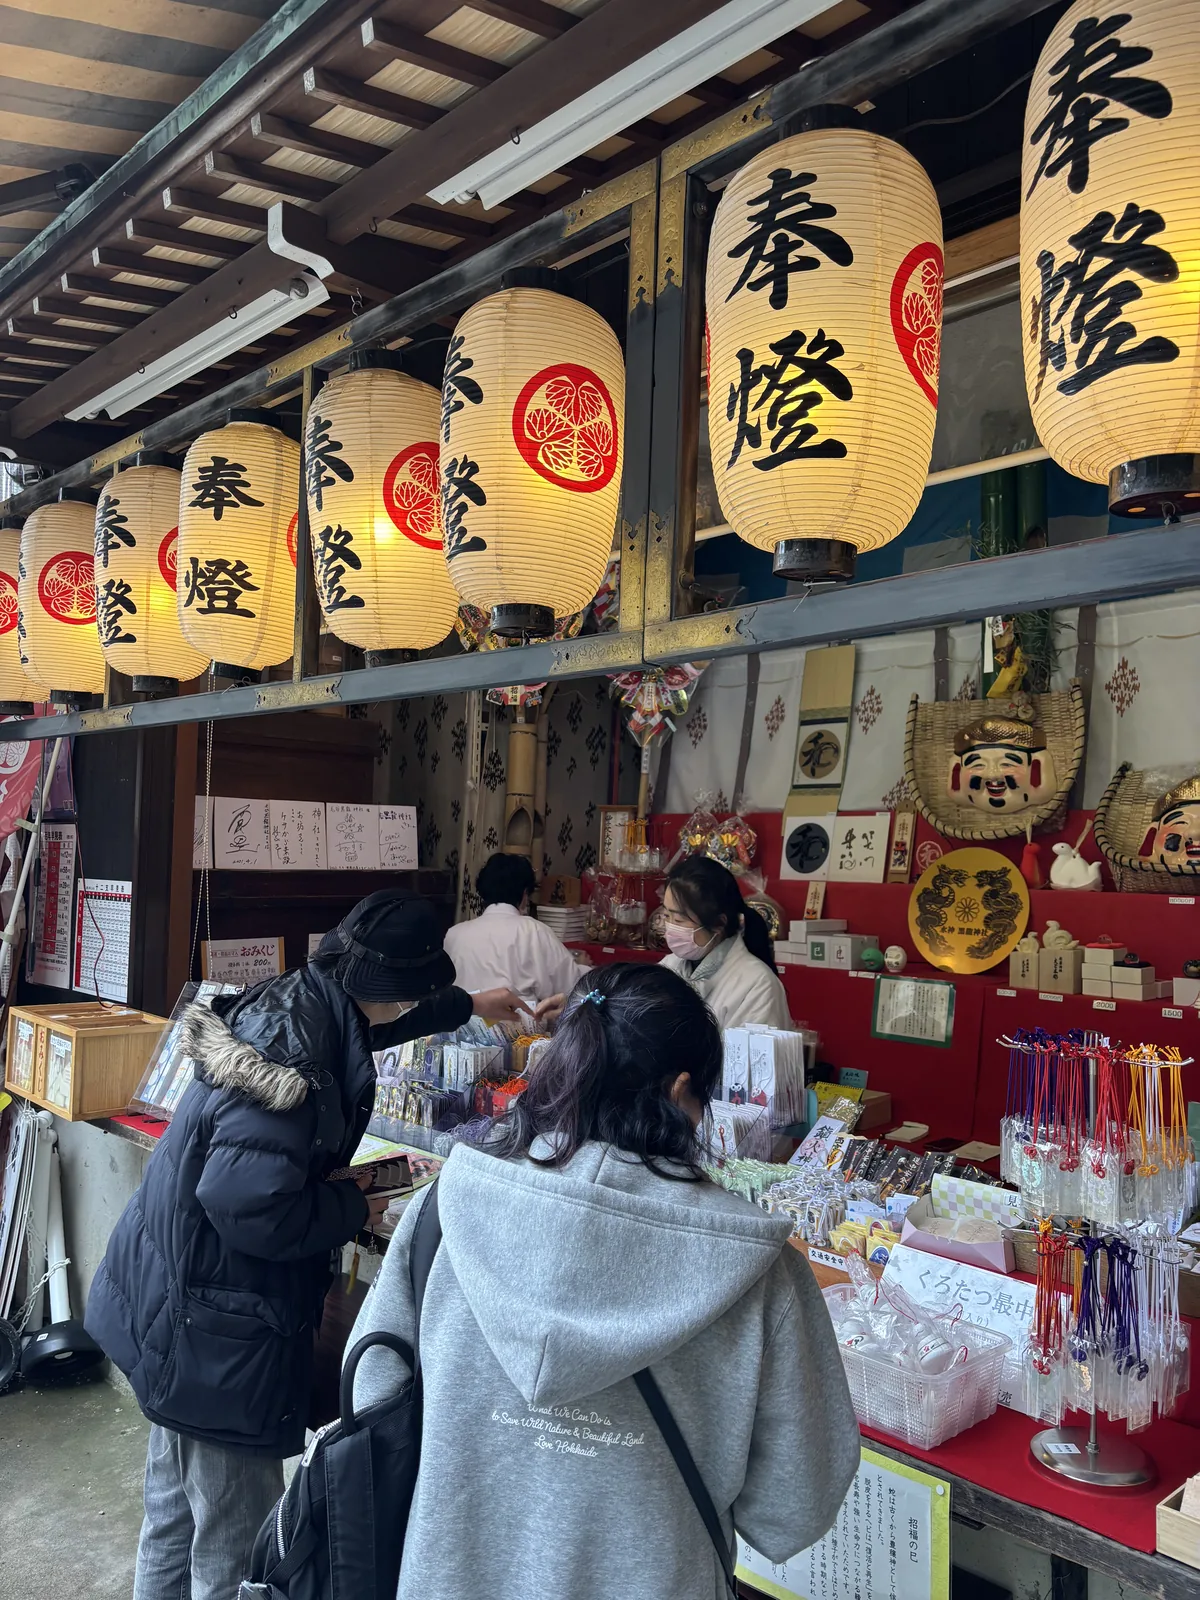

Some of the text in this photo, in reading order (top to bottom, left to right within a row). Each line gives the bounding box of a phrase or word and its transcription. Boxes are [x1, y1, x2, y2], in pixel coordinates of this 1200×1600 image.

[1026, 13, 1180, 404] 奉燈
[725, 168, 853, 471] 奉燈
[184, 456, 264, 618] 奉燈
[241, 944, 275, 957] おみくじ
[918, 1269, 1034, 1322] くろたつ最中
[491, 1410, 500, 1421] to
[500, 1412, 519, 1426] Save
[521, 1416, 544, 1430] Wild
[544, 1421, 572, 1437] Nature
[573, 1427, 580, 1439] &
[582, 1427, 621, 1446] Beautiful
[554, 1406, 571, 1419] We
[571, 1409, 589, 1422] Can
[590, 1411, 603, 1424] Do
[603, 1416, 612, 1426] is
[534, 1434, 599, 1458] Love Hokkaido
[908, 1516, 919, 1563] 招福の巳
